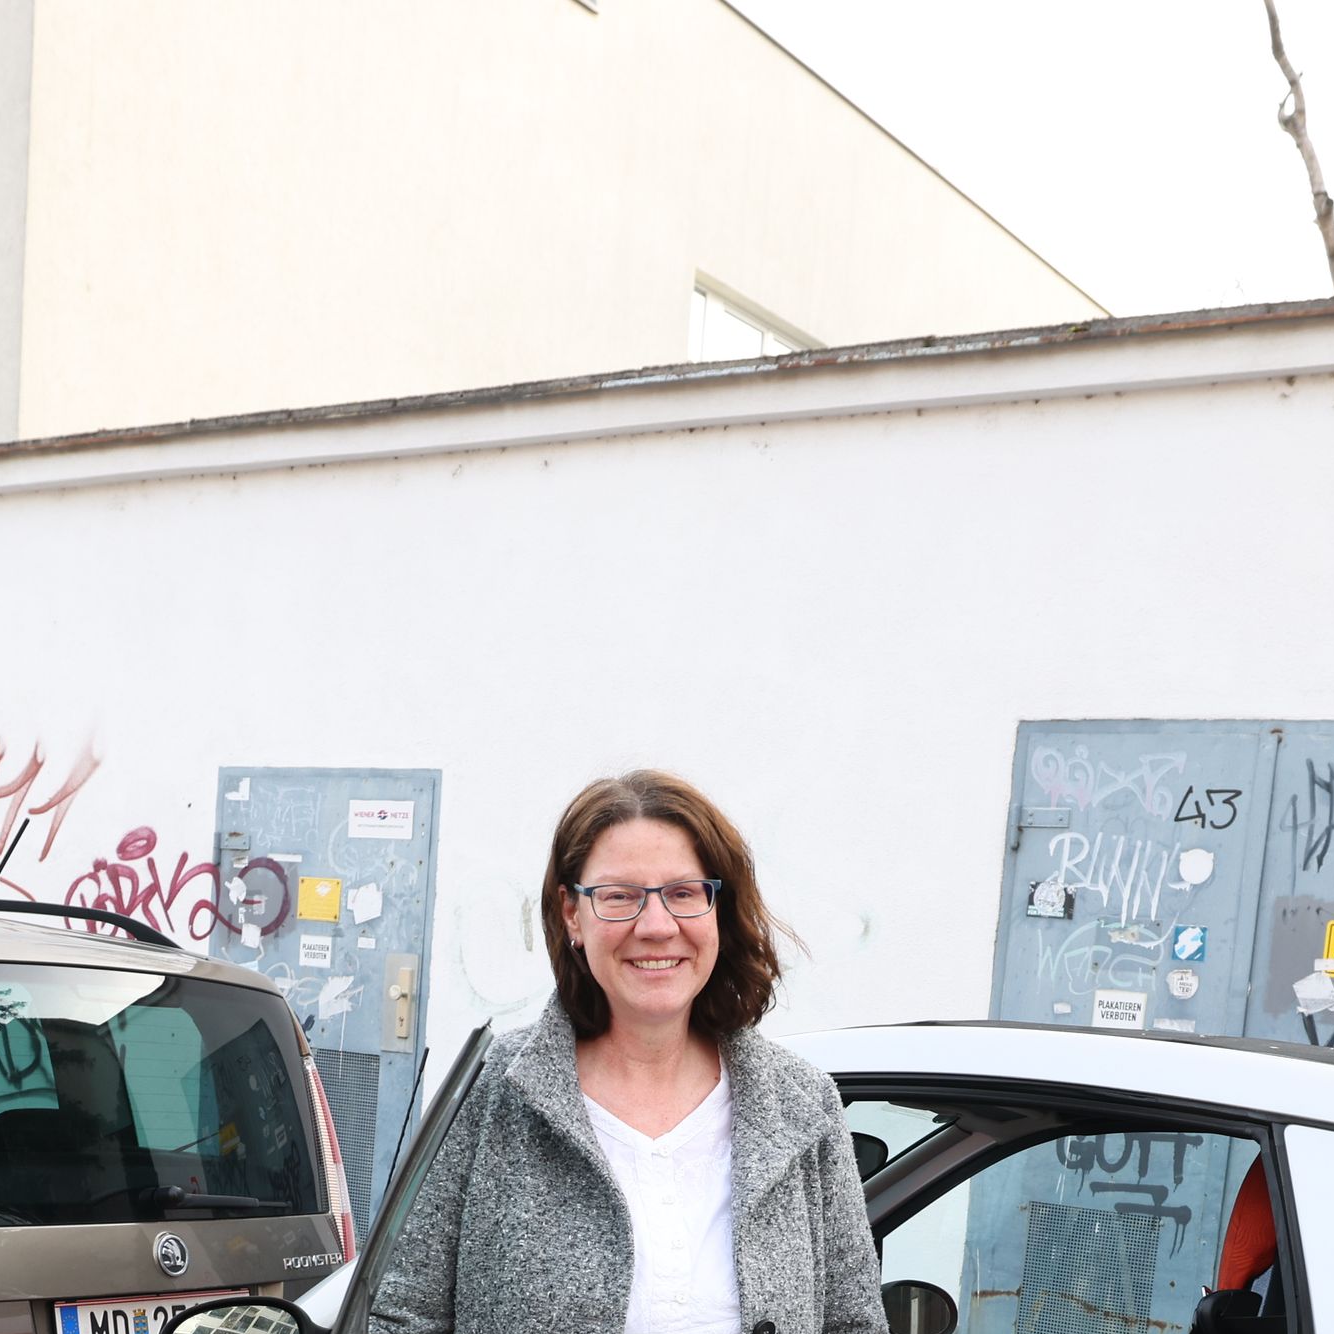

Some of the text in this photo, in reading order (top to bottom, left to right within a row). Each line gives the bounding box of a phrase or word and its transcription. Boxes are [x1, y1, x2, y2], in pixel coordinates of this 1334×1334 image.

[1174, 786, 1242, 829] 43
[302, 943, 330, 952] PLAKATIEREN
[304, 951, 327, 960] VERBOTEN
[1098, 1000, 1142, 1011] PLAKATIEREN
[1100, 1011, 1137, 1021] VERBOTEN
[283, 1252, 343, 1270] ROOMSTER
